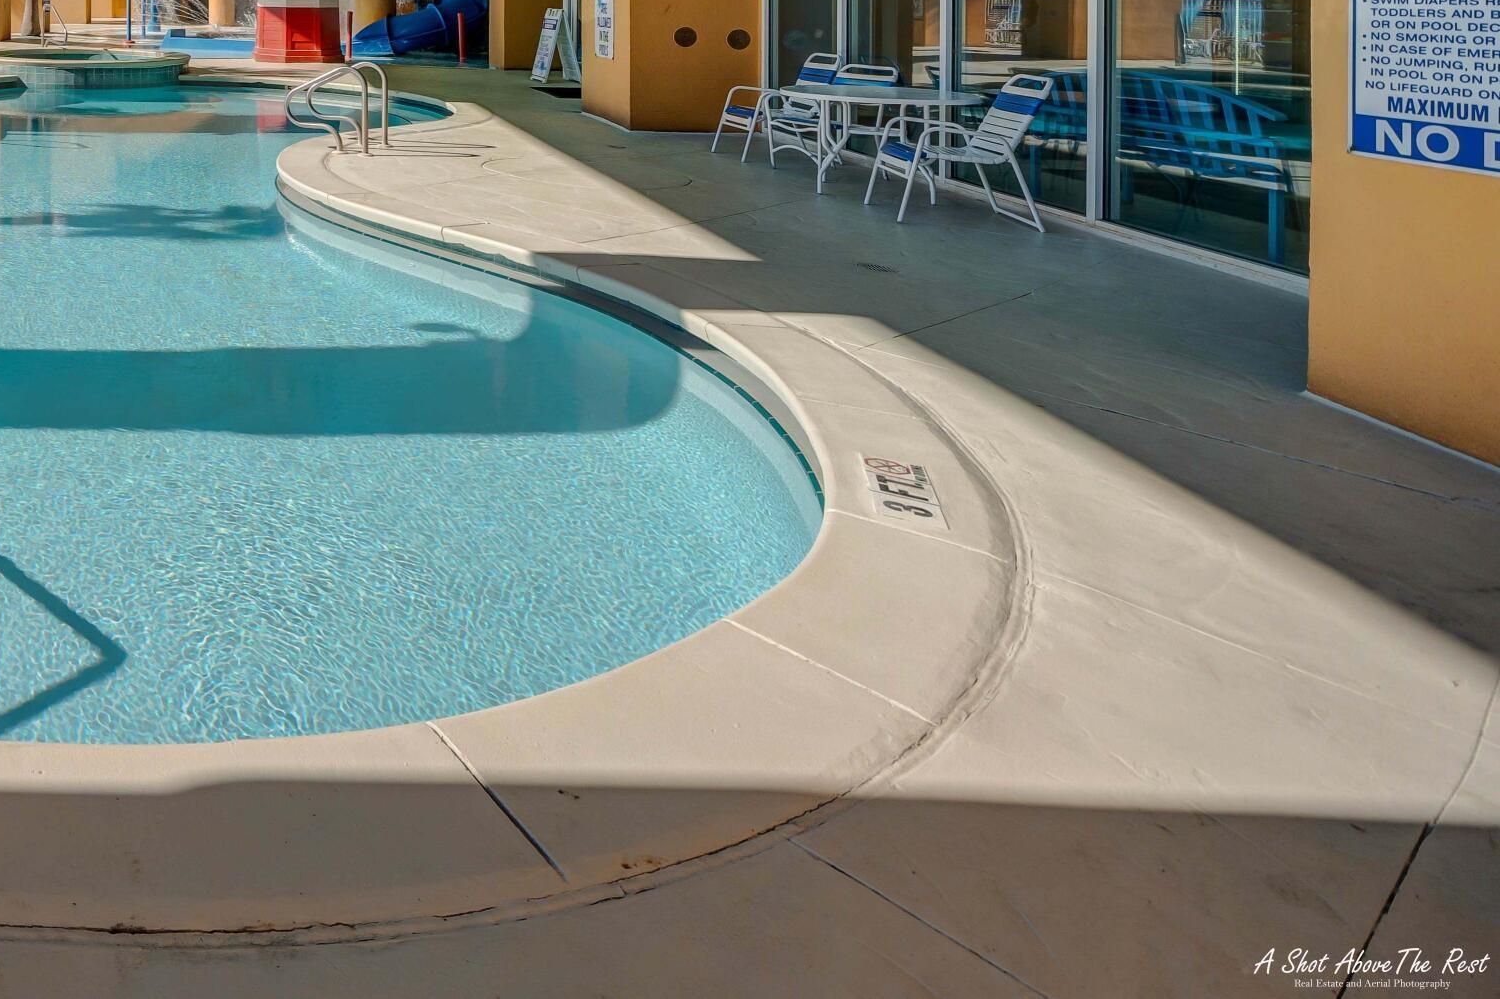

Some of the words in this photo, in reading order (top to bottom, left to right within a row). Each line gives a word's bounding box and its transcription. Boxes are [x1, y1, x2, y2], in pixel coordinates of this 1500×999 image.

[1370, 8, 1446, 18] TODDLERS
[1451, 8, 1485, 19] AND
[1371, 20, 1390, 29] OR
[1395, 20, 1416, 30] ON
[1421, 21, 1462, 32] POOL
[1467, 23, 1500, 33] DEC
[1370, 32, 1391, 41] NO
[1395, 32, 1467, 45] SMOKING
[1472, 35, 1496, 46] OR
[1370, 44, 1384, 53] IN
[1389, 44, 1428, 55] CASE
[1432, 46, 1453, 56] OF
[1457, 48, 1500, 59] EMER
[1370, 56, 1391, 65] NO
[1395, 57, 1468, 71] JUMPING,
[1474, 62, 1500, 73] RU
[1370, 68, 1384, 77] IN
[1389, 69, 1428, 80] POOL
[1432, 72, 1454, 82] OR
[1459, 74, 1483, 84] ON
[1489, 76, 1500, 85] P
[1365, 80, 1385, 90] NO
[1390, 82, 1473, 98] LIFEGUARD
[1478, 90, 1500, 101] ON
[1388, 96, 1489, 123] MAXIMUM
[1375, 119, 1460, 162] NO
[883, 500, 933, 518] 3
